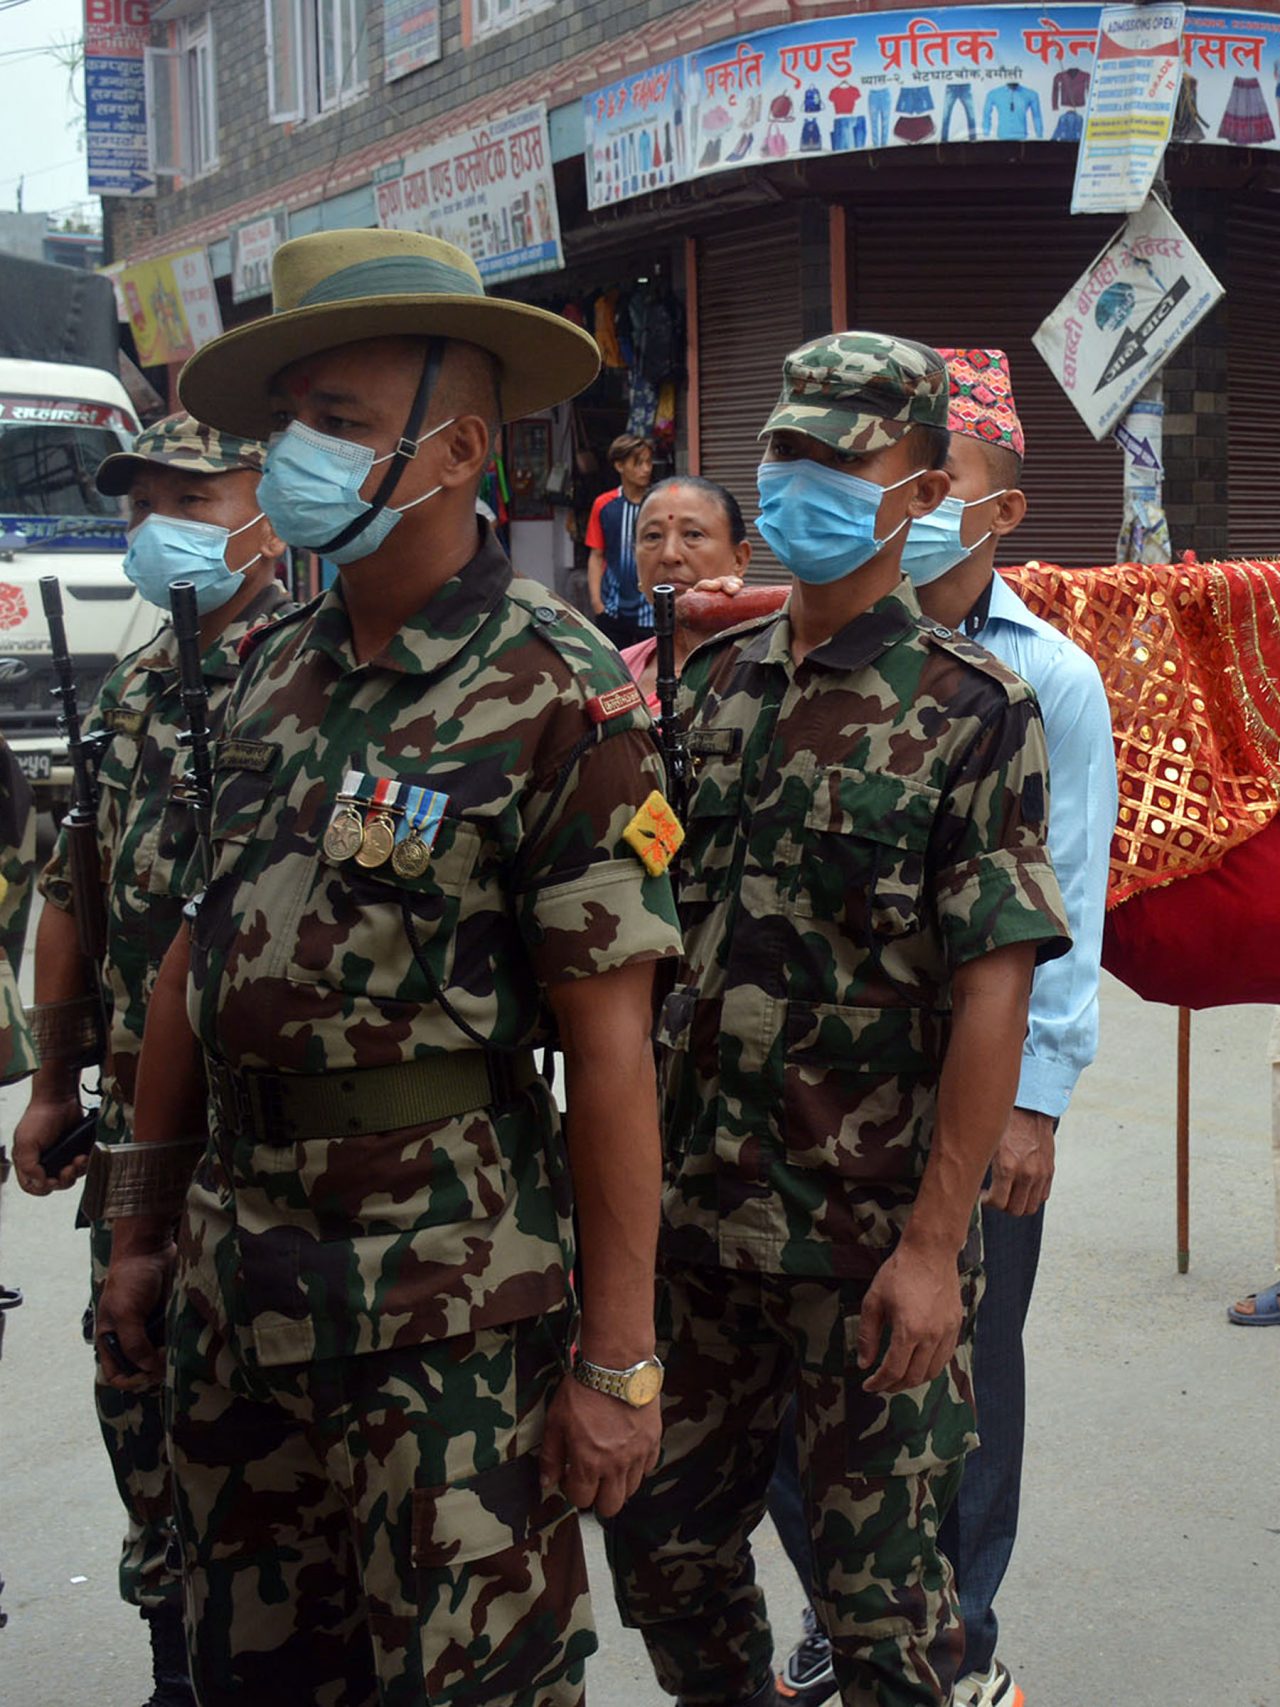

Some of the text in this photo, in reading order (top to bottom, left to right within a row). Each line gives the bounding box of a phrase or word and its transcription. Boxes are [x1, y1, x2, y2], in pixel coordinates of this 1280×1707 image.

[87, 0, 150, 26] BIG
[1107, 18, 1152, 32] ADMISSIONS
[779, 38, 857, 90] एण्ड
[877, 18, 998, 71] प्रतिक
[1148, 60, 1174, 97] GRADE
